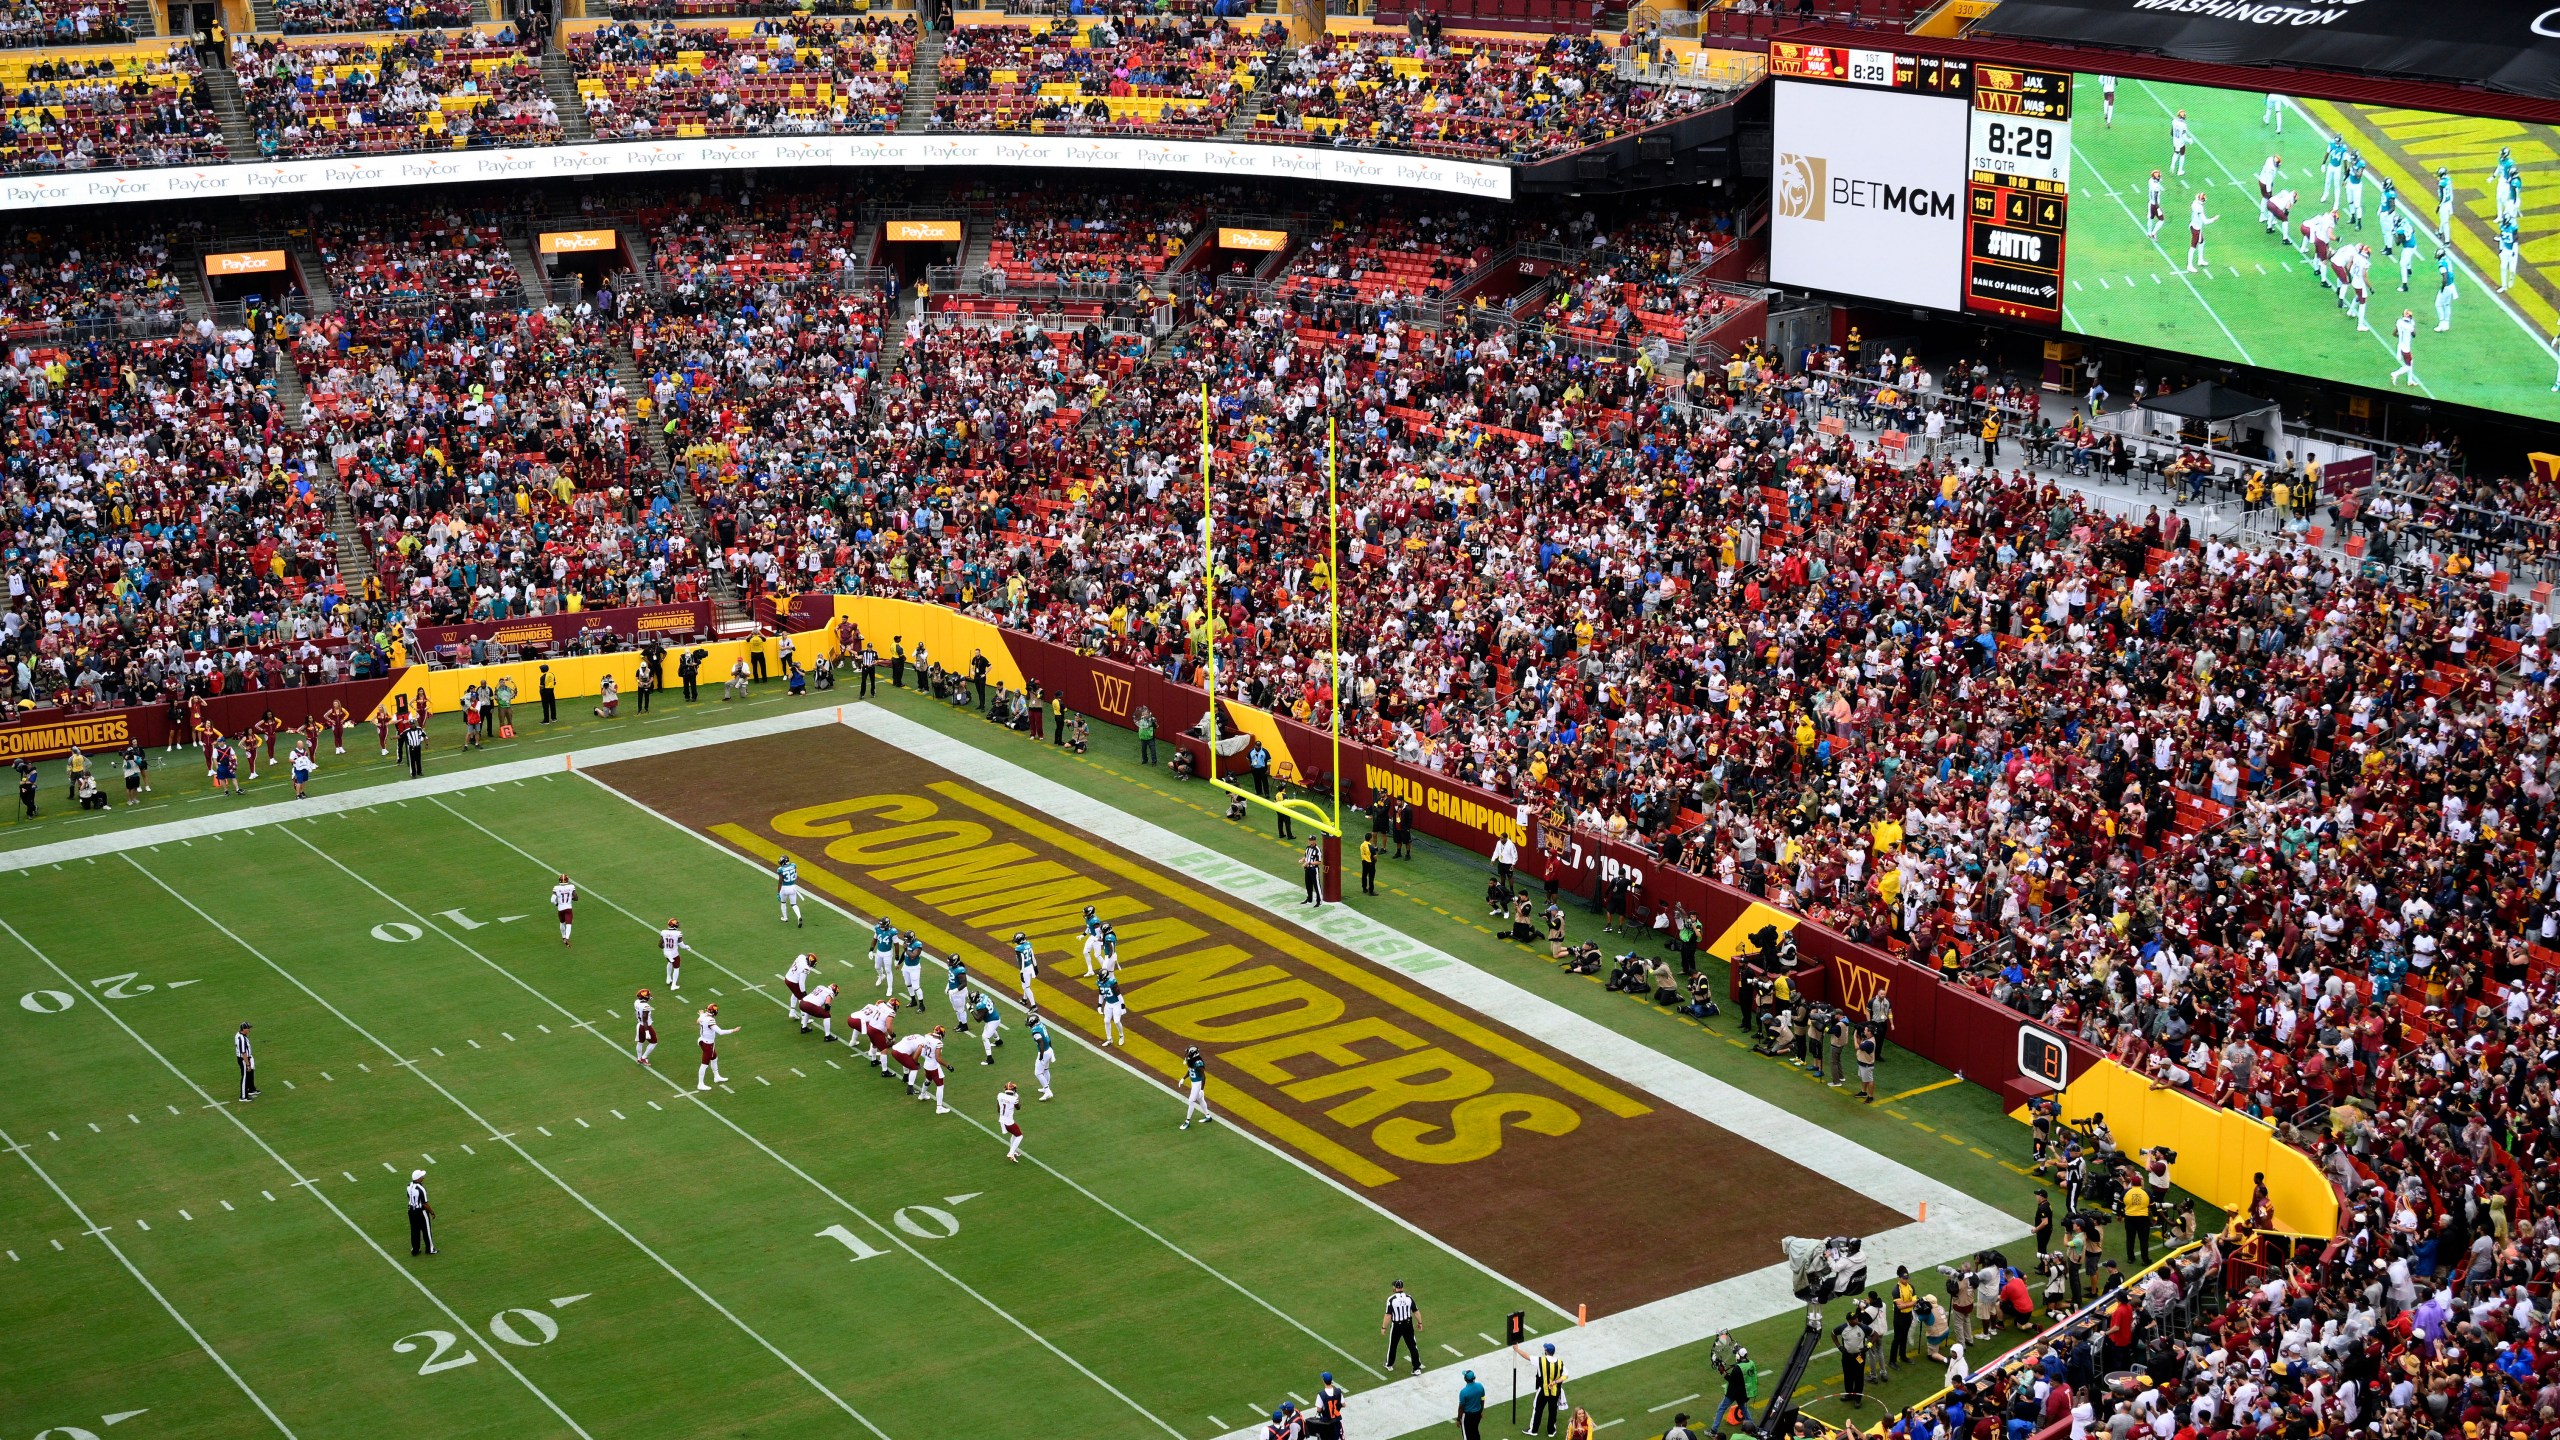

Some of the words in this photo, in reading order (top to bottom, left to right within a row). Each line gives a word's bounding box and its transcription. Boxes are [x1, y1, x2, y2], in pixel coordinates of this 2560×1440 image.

[1957, 4, 1973, 14] 330
[2133, 0, 2348, 25] WASHINGTON
[1808, 47, 1824, 57] JAX
[1866, 54, 1879, 63] 1ST
[1807, 61, 1825, 71] WAS
[1894, 56, 1915, 65] DOWN
[1928, 59, 1938, 67] GO
[1944, 61, 1957, 69] BALL
[1854, 65, 1884, 81] 8:29
[1896, 70, 1913, 82] 1ST
[1928, 72, 1938, 85] 4
[1950, 74, 1960, 88] 4
[2023, 76, 2043, 88] JAX
[2057, 82, 2064, 93] 3
[2023, 100, 2045, 112] WAS
[2057, 105, 2064, 116] 0
[1988, 123, 2052, 160] 8:29
[628, 152, 685, 165] Paycor
[702, 149, 759, 162] Paycor
[777, 146, 832, 160] Paycor
[851, 146, 906, 159] Paycor
[924, 145, 979, 159] Paycor
[997, 146, 1051, 159] Paycor
[1067, 147, 1122, 161] Paycor
[1138, 149, 1189, 164] Paycor
[478, 159, 535, 173] Paycor
[553, 155, 610, 169] Paycor
[1204, 152, 1256, 168] Paycor
[1272, 155, 1320, 171] Paycor
[1975, 157, 1991, 168] 1ST
[1995, 160, 2015, 172] QTR
[402, 163, 461, 178] Paycor
[1335, 160, 1383, 176] Paycor
[1398, 166, 1443, 182] Paycor
[2052, 168, 2057, 178] 8
[248, 172, 308, 186] Paycor
[326, 168, 384, 182] Paycor
[1456, 172, 1498, 189] Paycor
[1974, 171, 1995, 183] DOWN
[169, 177, 229, 192] Paycor
[2008, 176, 2018, 187] TO
[2018, 178, 2028, 188] GO
[2035, 180, 2052, 191] BALL
[2054, 183, 2064, 193] ON
[8, 186, 68, 202] Paycor
[89, 182, 149, 196] Paycor
[1833, 177, 1955, 220] BETMGM
[1975, 197, 1993, 211] 1ST
[2013, 200, 2023, 216] 4
[2044, 205, 2055, 221] 4
[901, 226, 945, 238] Paycor
[555, 236, 599, 249] Paycor
[1232, 233, 1273, 246] Paycor
[1987, 229, 2041, 262] #HTTC
[222, 258, 267, 270] Paycor
[1519, 262, 1534, 273] 229
[1973, 277, 1993, 288] BANK
[1994, 279, 2004, 289] OF
[2005, 283, 2040, 295] AMERICA
[1225, 308, 1233, 316] 23
[1010, 424, 1018, 433] 17
[890, 463, 898, 471] 21
[483, 477, 493, 486] 16
[1385, 504, 1393, 512] 71
[1396, 509, 1405, 518] 44
[1471, 546, 1480, 554] 20
[859, 565, 865, 573] 17
[1195, 582, 1200, 590] 9
[1719, 577, 1727, 585] 17
[500, 622, 547, 630] WASHINGTON
[638, 616, 694, 629] COMMANDERS
[496, 629, 552, 642] COMMANDERS
[1113, 642, 1119, 650] 17
[309, 665, 318, 673] 99
[1779, 689, 1789, 699] 99
[399, 697, 405, 708] 1
[2217, 703, 2226, 712] 17
[0, 721, 128, 754] COMMANDERS
[503, 725, 514, 737] G
[2155, 745, 2165, 757] 21
[1550, 754, 1558, 763] 47
[1365, 763, 1423, 806] WORLD
[1427, 787, 1527, 847] CHAMPIONS
[2383, 824, 2391, 833] 17
[783, 871, 797, 882] 32
[561, 893, 570, 904] 17
[1168, 851, 1268, 890] END
[1257, 890, 1453, 974] RACISM
[665, 937, 674, 949] 10
[877, 935, 890, 945] 44
[771, 794, 1581, 1164] COMMANDERS
[1099, 987, 1113, 998] 23
[2537, 989, 2542, 998] 7
[2044, 1044, 2059, 1078] 8
[814, 1205, 959, 1262] 10
[1512, 1315, 1519, 1334] 1
[393, 1308, 558, 1375] 20
[2218, 1361, 2224, 1373] 8
